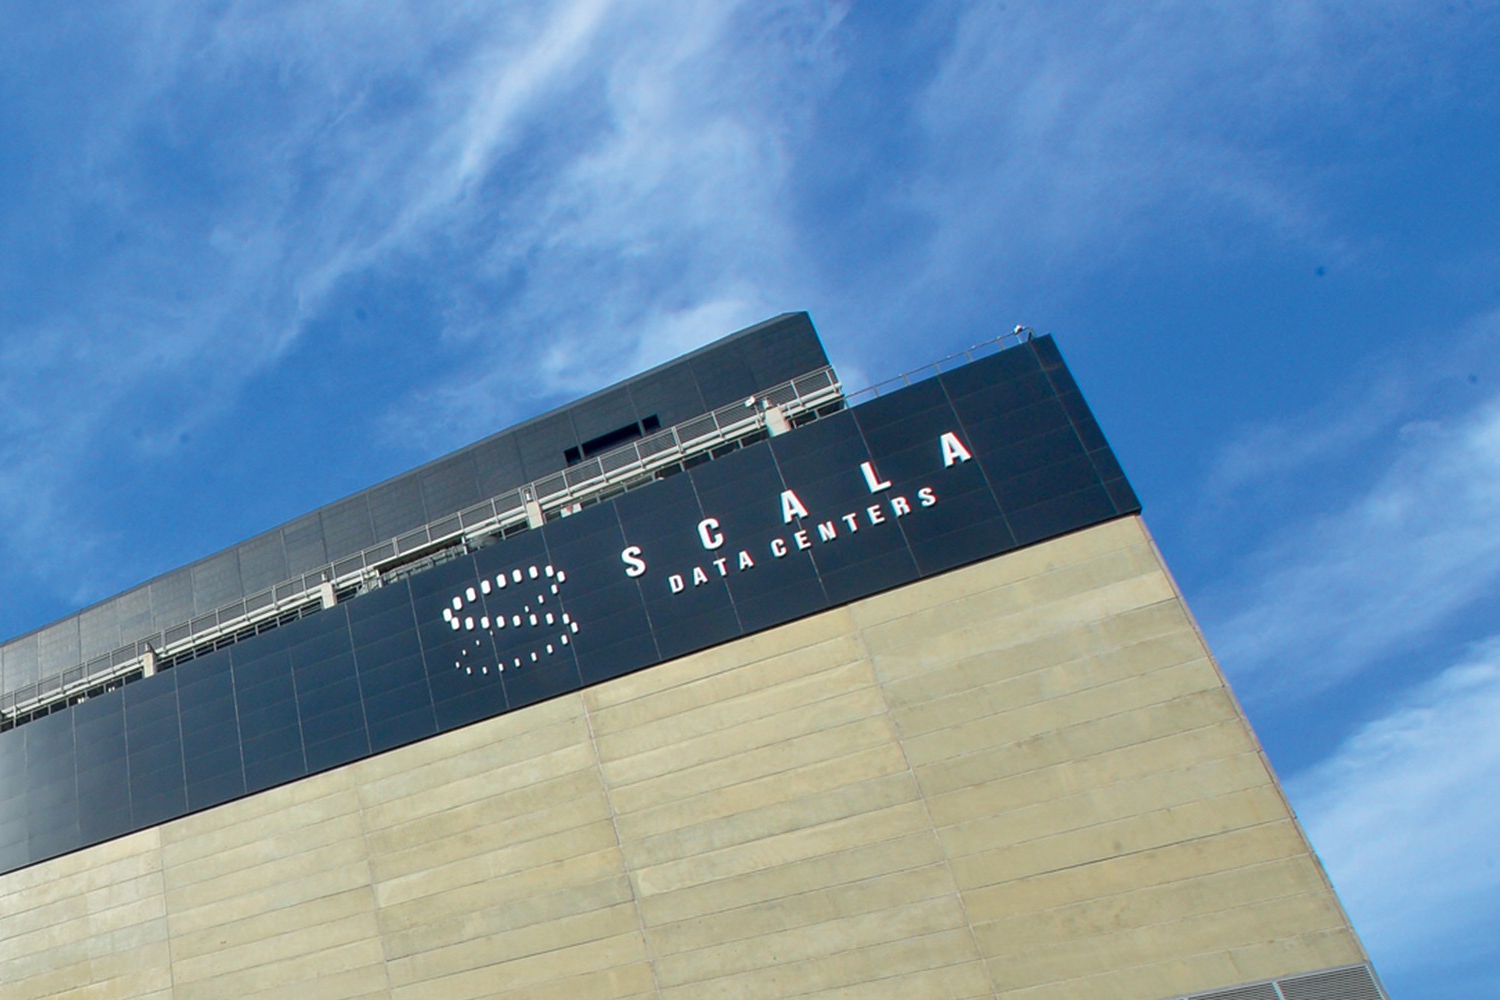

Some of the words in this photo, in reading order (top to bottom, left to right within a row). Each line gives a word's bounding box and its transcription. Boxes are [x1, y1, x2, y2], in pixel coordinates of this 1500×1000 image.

[621, 431, 972, 578] SCALA
[668, 548, 754, 594] DATA
[770, 486, 937, 558] CENTERS
